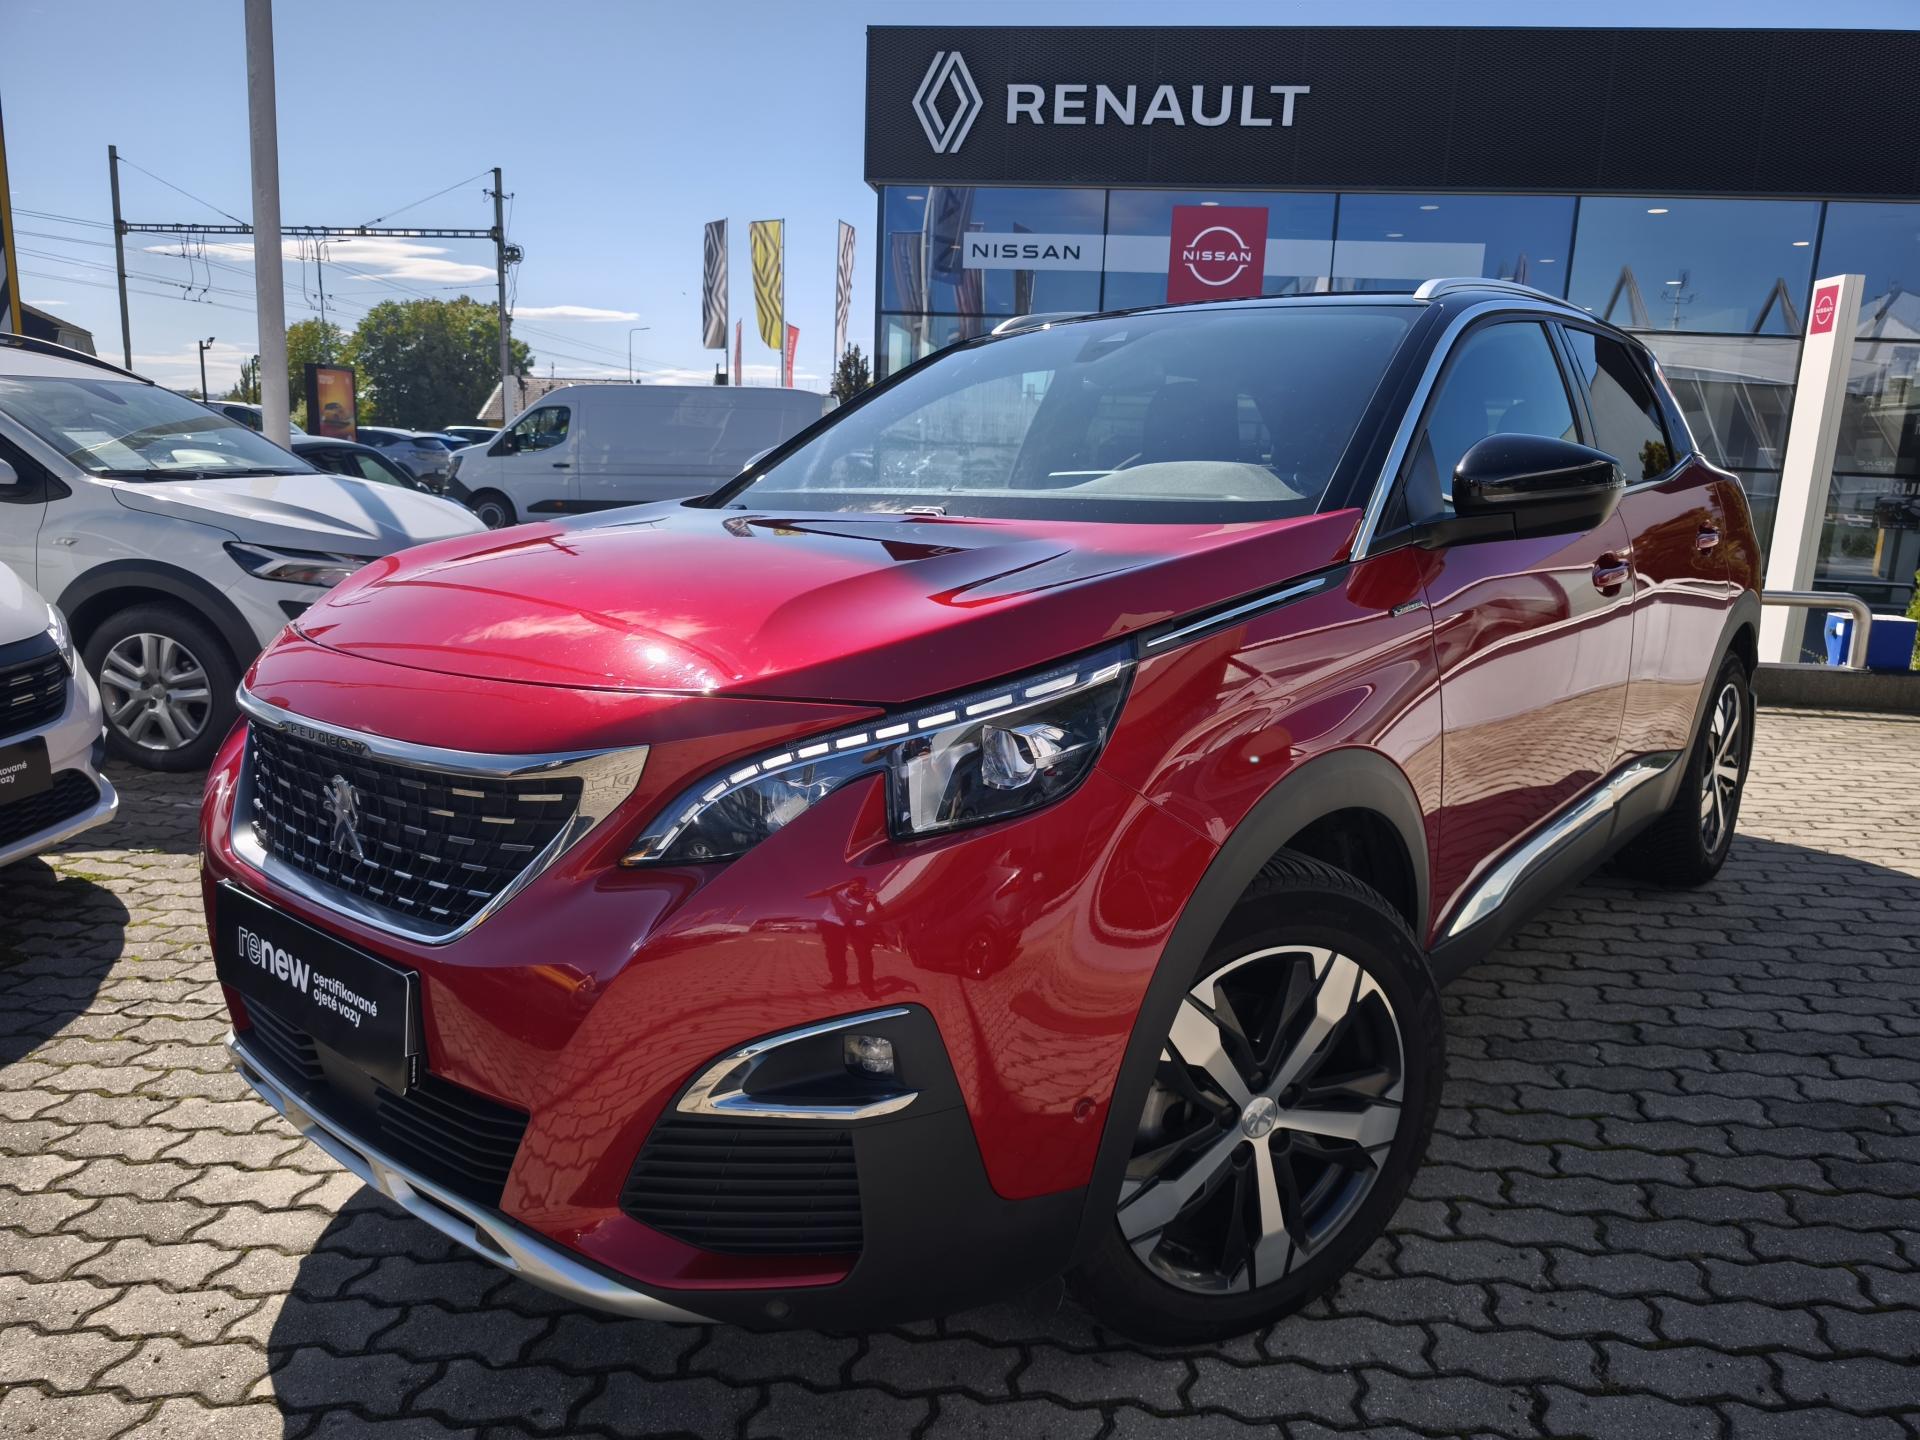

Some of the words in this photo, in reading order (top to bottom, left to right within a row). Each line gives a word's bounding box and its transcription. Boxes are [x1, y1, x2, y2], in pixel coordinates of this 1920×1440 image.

[1006, 84, 1310, 127] RENAULT
[972, 243, 1081, 260] NISSAN
[1183, 250, 1251, 262] NISSAN
[291, 724, 361, 754] PEUGEOT
[238, 926, 310, 993] renew
[313, 972, 377, 1016] certifikované
[313, 988, 337, 1011] ojeté
[338, 1002, 361, 1028] vozy
